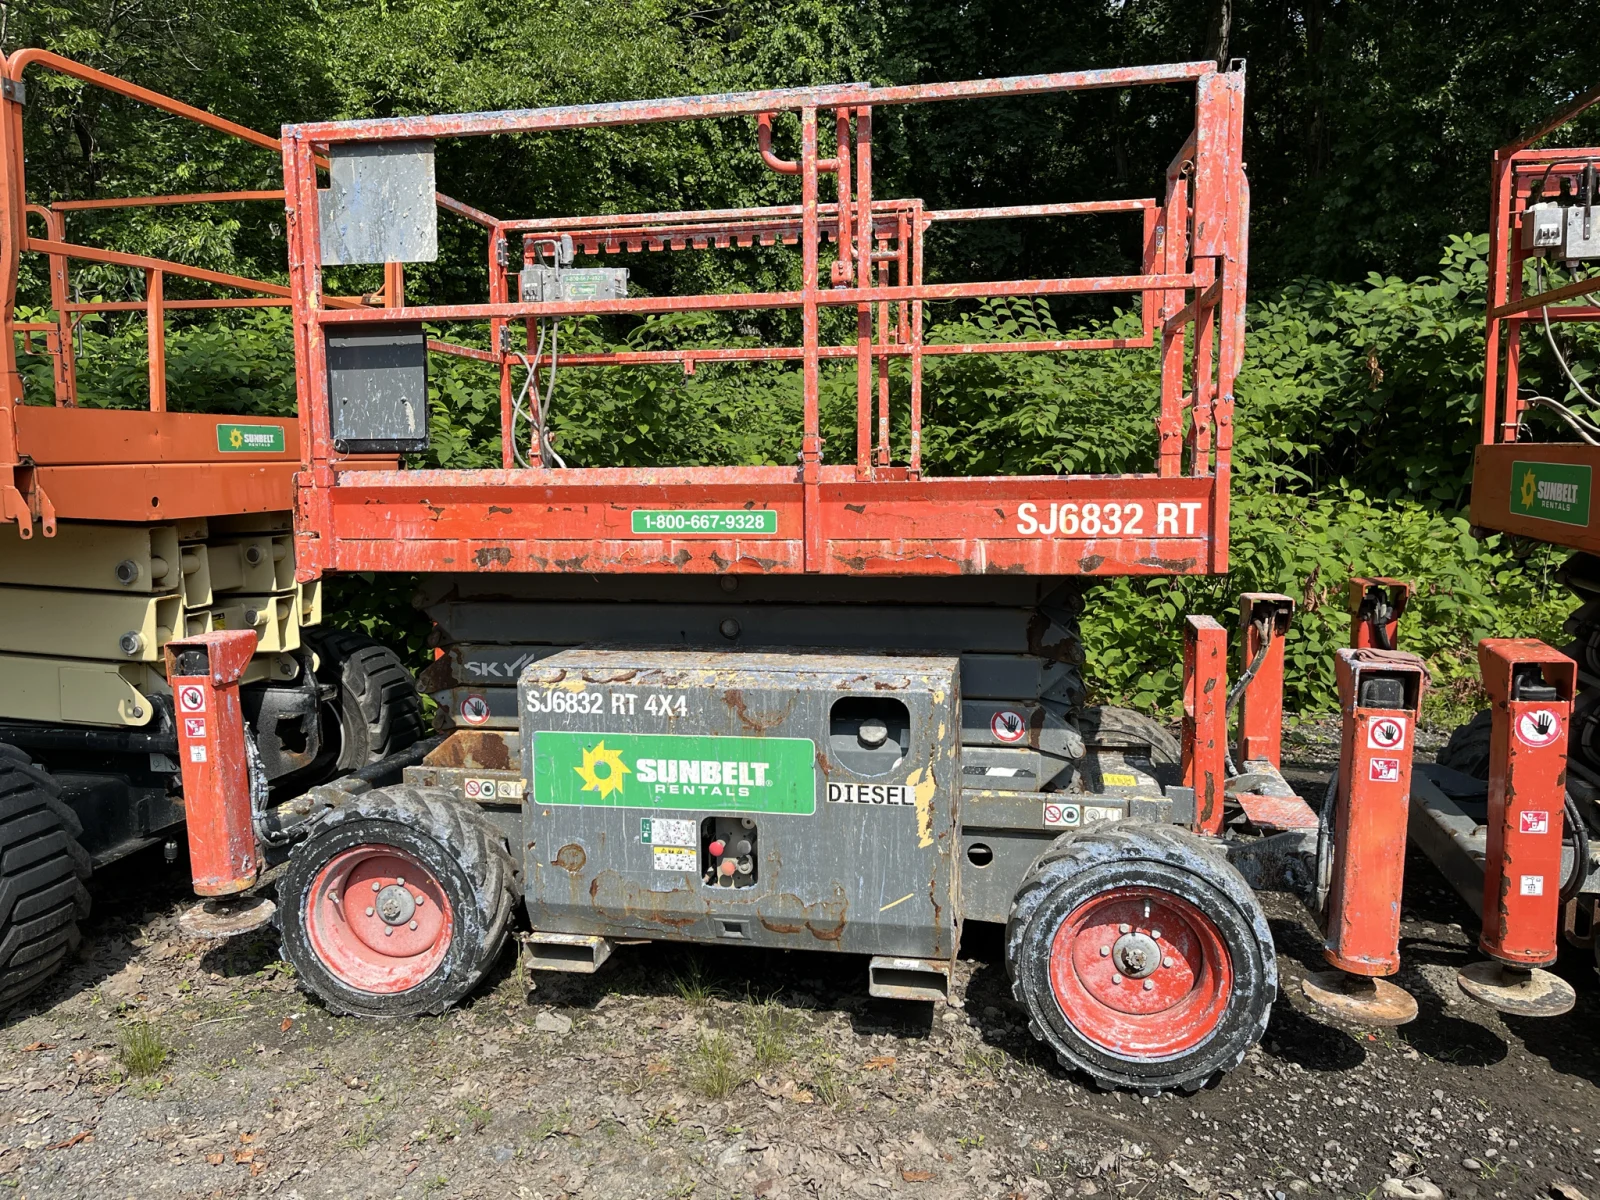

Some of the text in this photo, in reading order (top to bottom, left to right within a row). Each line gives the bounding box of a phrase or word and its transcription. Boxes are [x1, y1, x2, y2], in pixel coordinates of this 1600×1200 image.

[243, 433, 274, 443] SUNBELT
[1537, 481, 1578, 504] SUNBELT
[1541, 500, 1571, 512] RENTALS
[643, 514, 765, 529] 1-800-667-9328
[1016, 502, 1202, 535] SJ6832 RT
[526, 690, 688, 717] SJ6832 RT 4X4
[636, 758, 770, 787] SUNBELT
[655, 784, 750, 797] RENTALS
[828, 783, 915, 806] DIESEL
